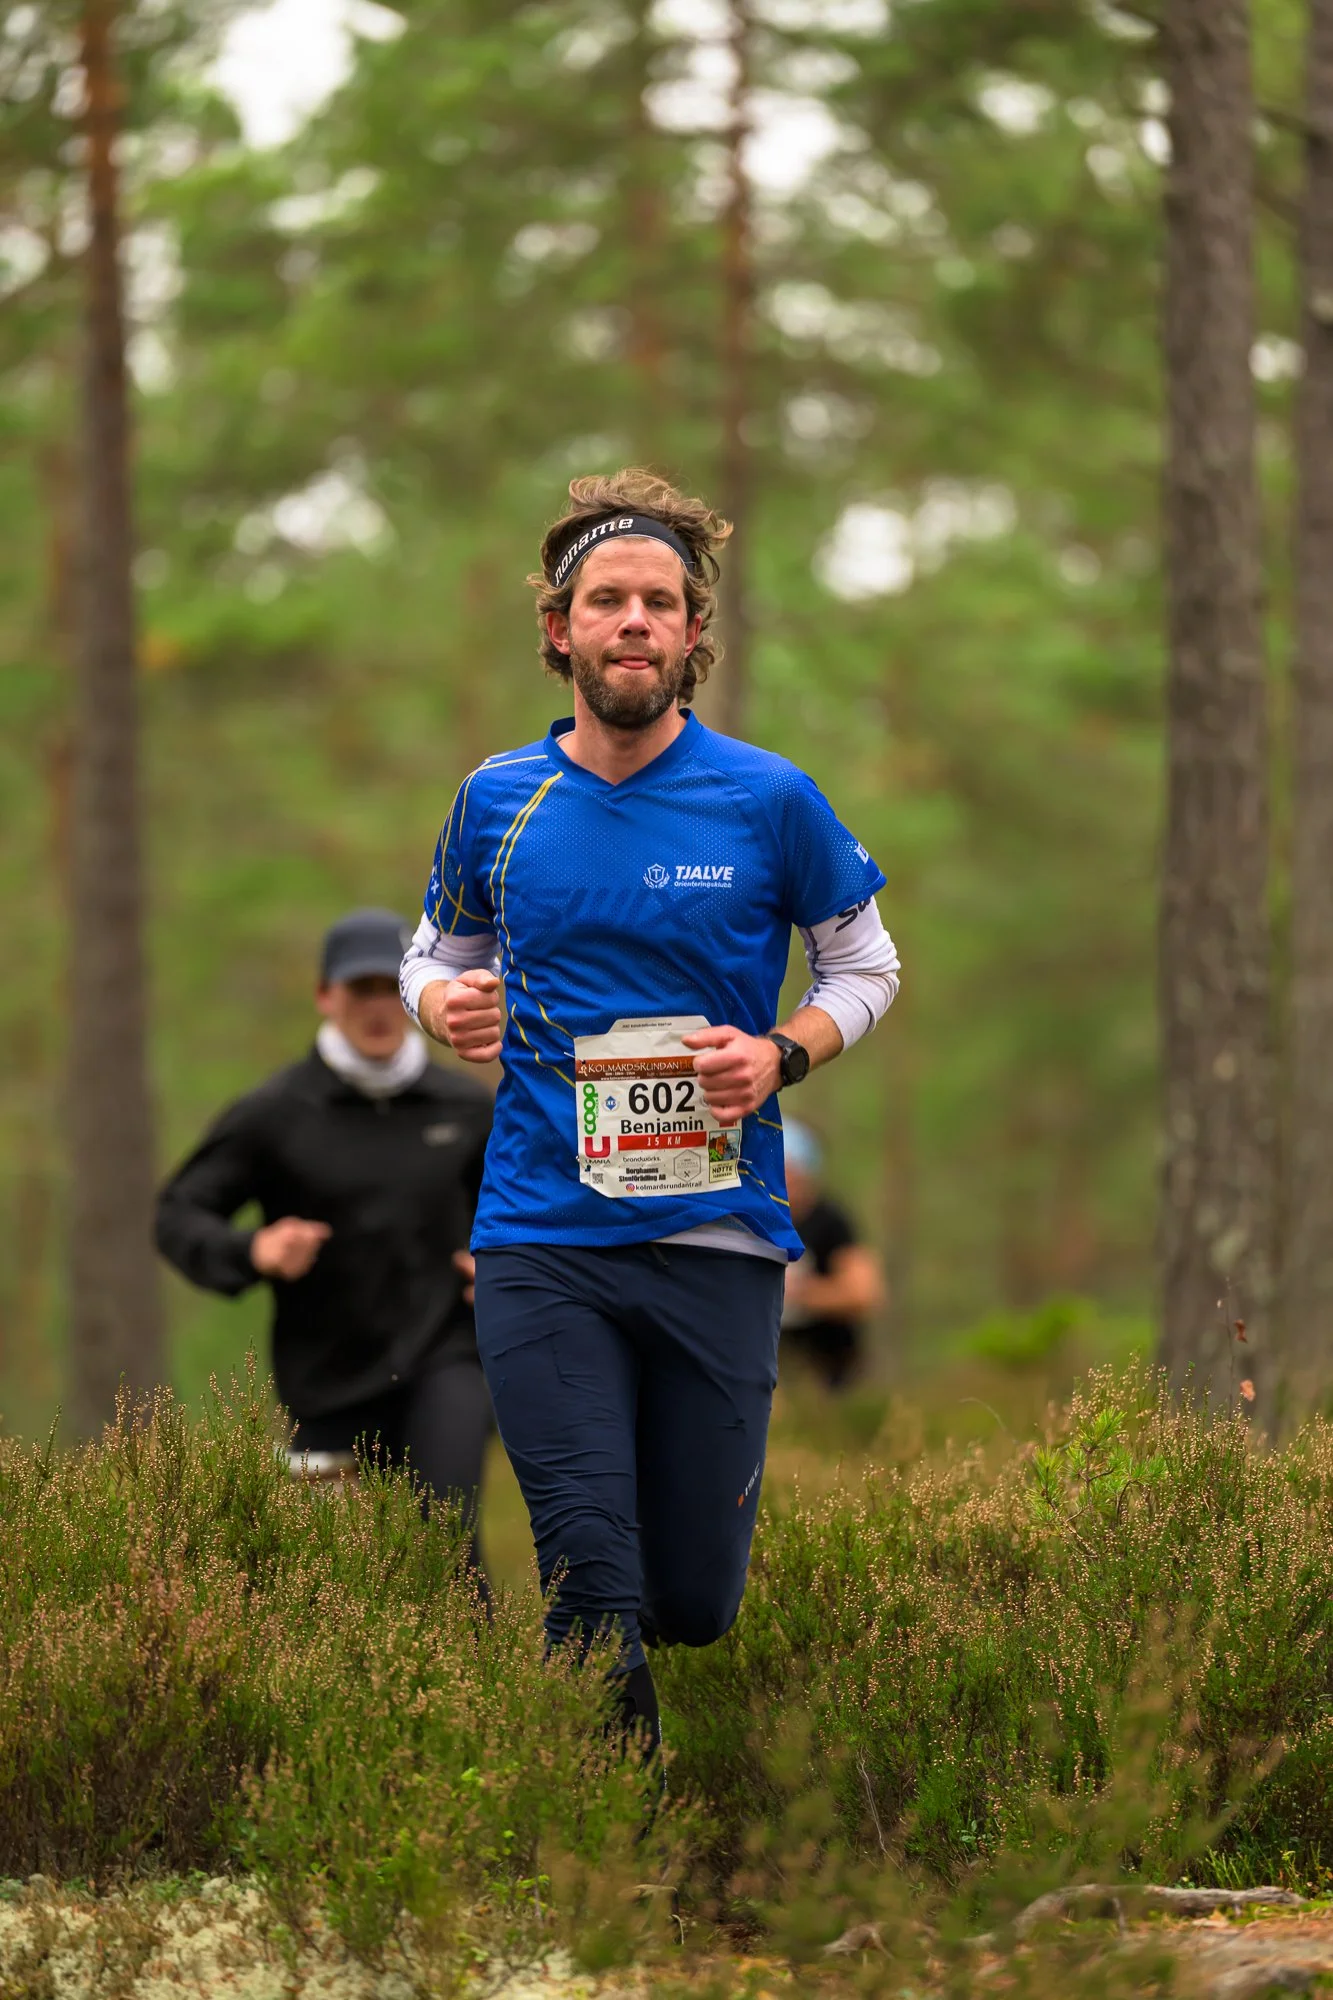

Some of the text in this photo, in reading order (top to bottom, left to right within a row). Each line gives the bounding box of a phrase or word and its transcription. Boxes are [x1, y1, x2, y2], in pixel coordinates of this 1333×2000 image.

[554, 518, 634, 587] noname
[675, 865, 735, 881] TJALVE
[583, 1083, 598, 1135] coop
[628, 1080, 696, 1115] 602
[621, 1116, 704, 1136] Benjamin
[647, 1135, 681, 1147] 15 KM
